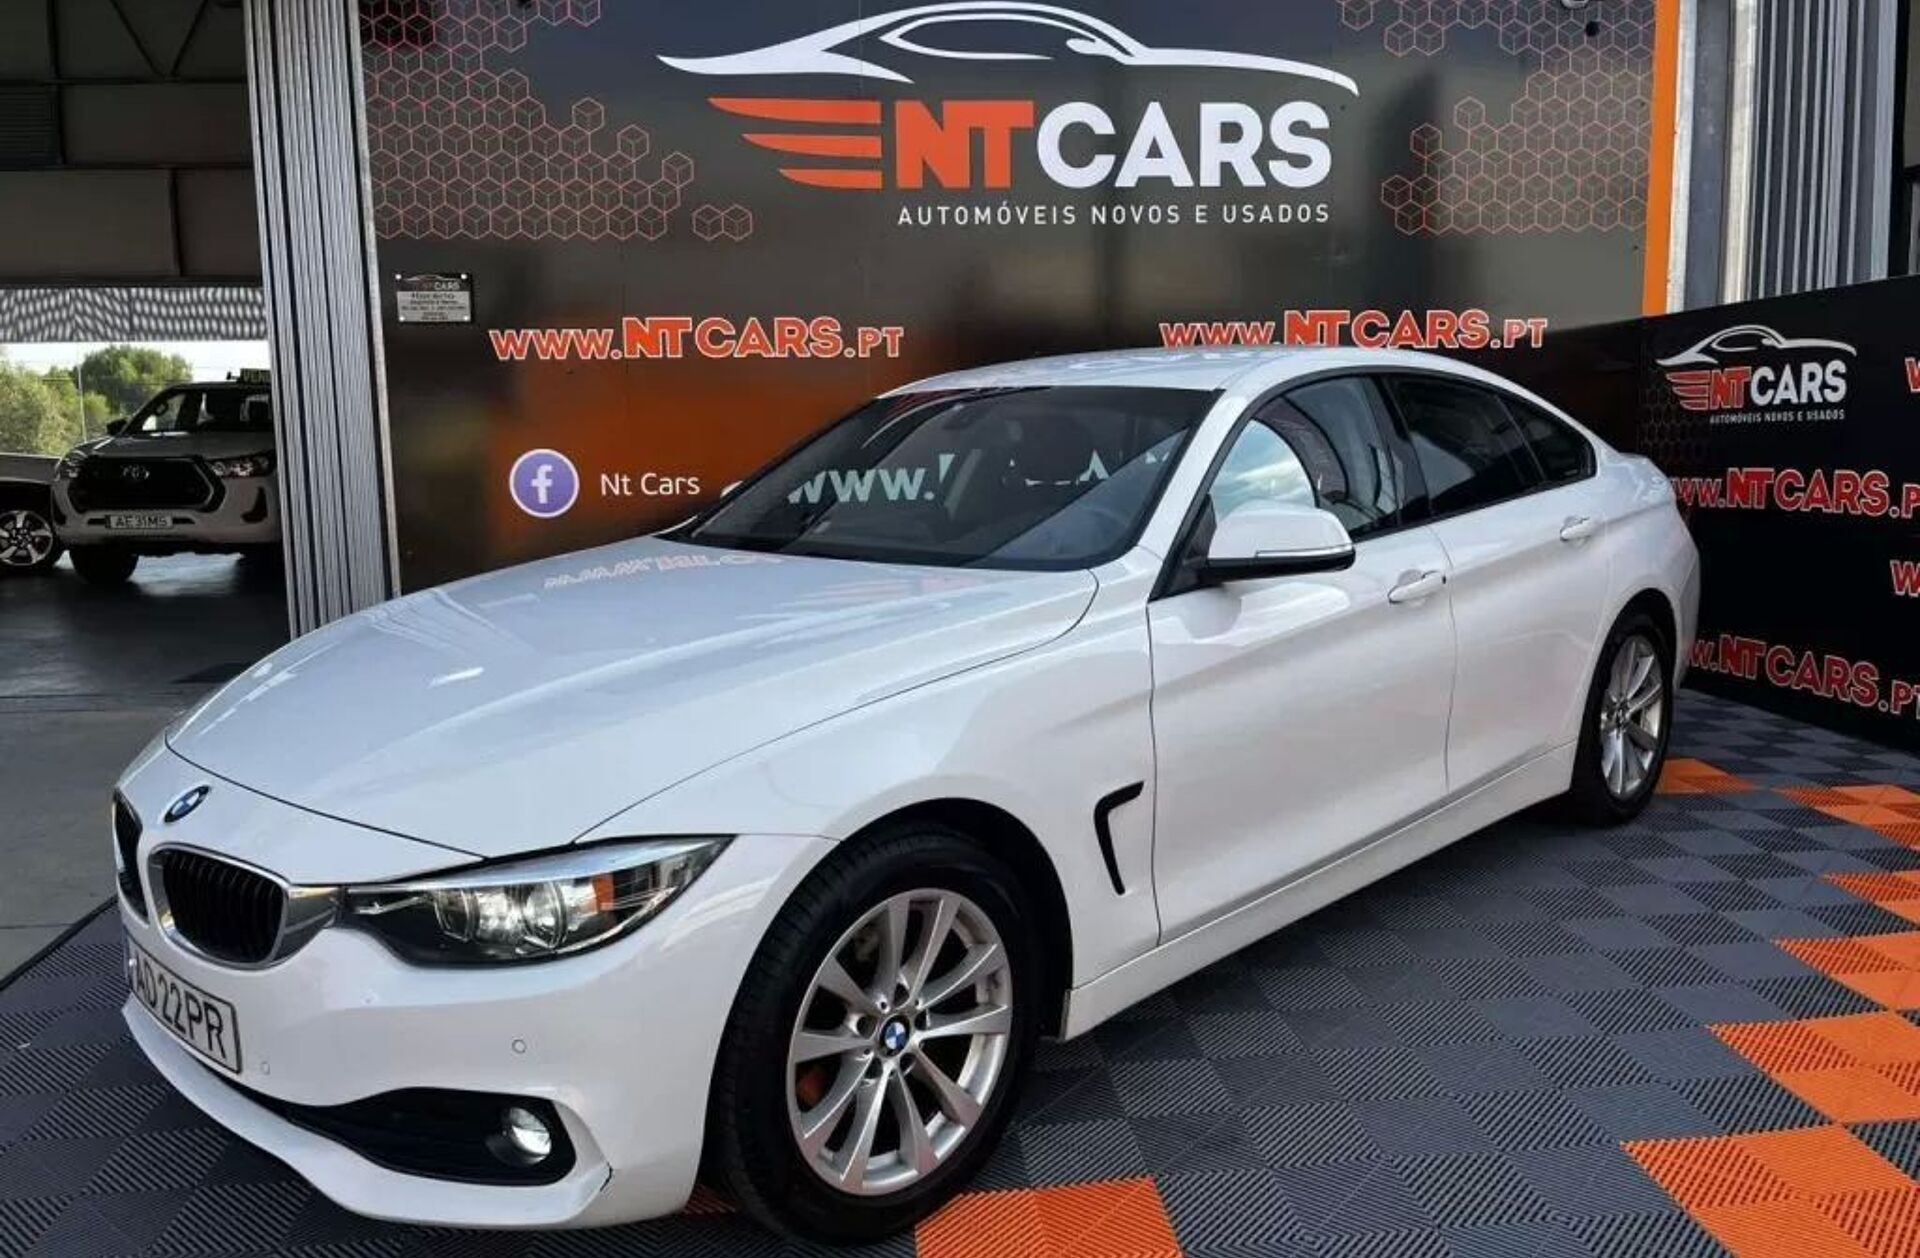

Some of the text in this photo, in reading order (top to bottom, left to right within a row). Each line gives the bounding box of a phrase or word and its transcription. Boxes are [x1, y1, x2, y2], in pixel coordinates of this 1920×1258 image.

[898, 201, 1330, 226] AUTOMÓVEIS NOVOS E USADOS
[1797, 409, 1803, 422] E
[600, 472, 701, 497] Nt Cars
